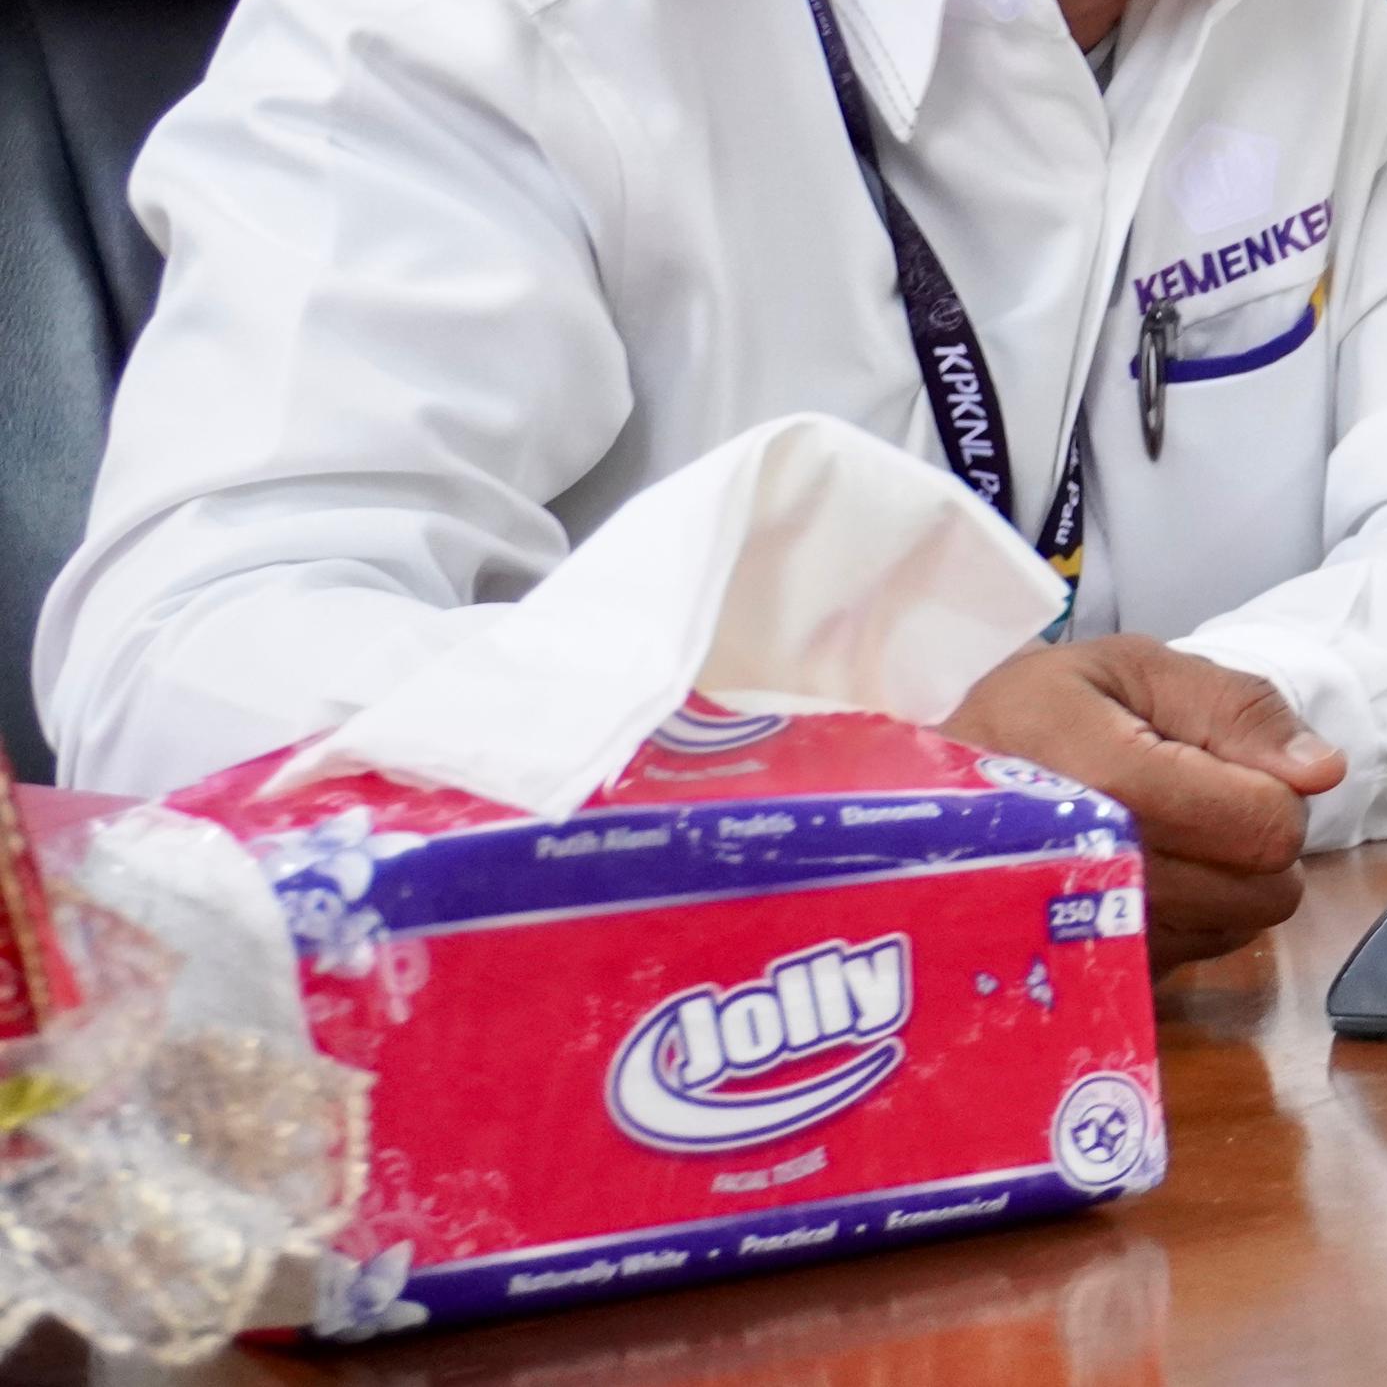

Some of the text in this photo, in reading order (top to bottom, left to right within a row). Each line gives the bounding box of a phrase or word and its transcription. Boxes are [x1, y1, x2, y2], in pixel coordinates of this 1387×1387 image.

[932, 342, 996, 465] KPKNL
[1050, 897, 1097, 927] 250
[1111, 896, 1129, 920] 2
[672, 938, 907, 1094] Jolly
